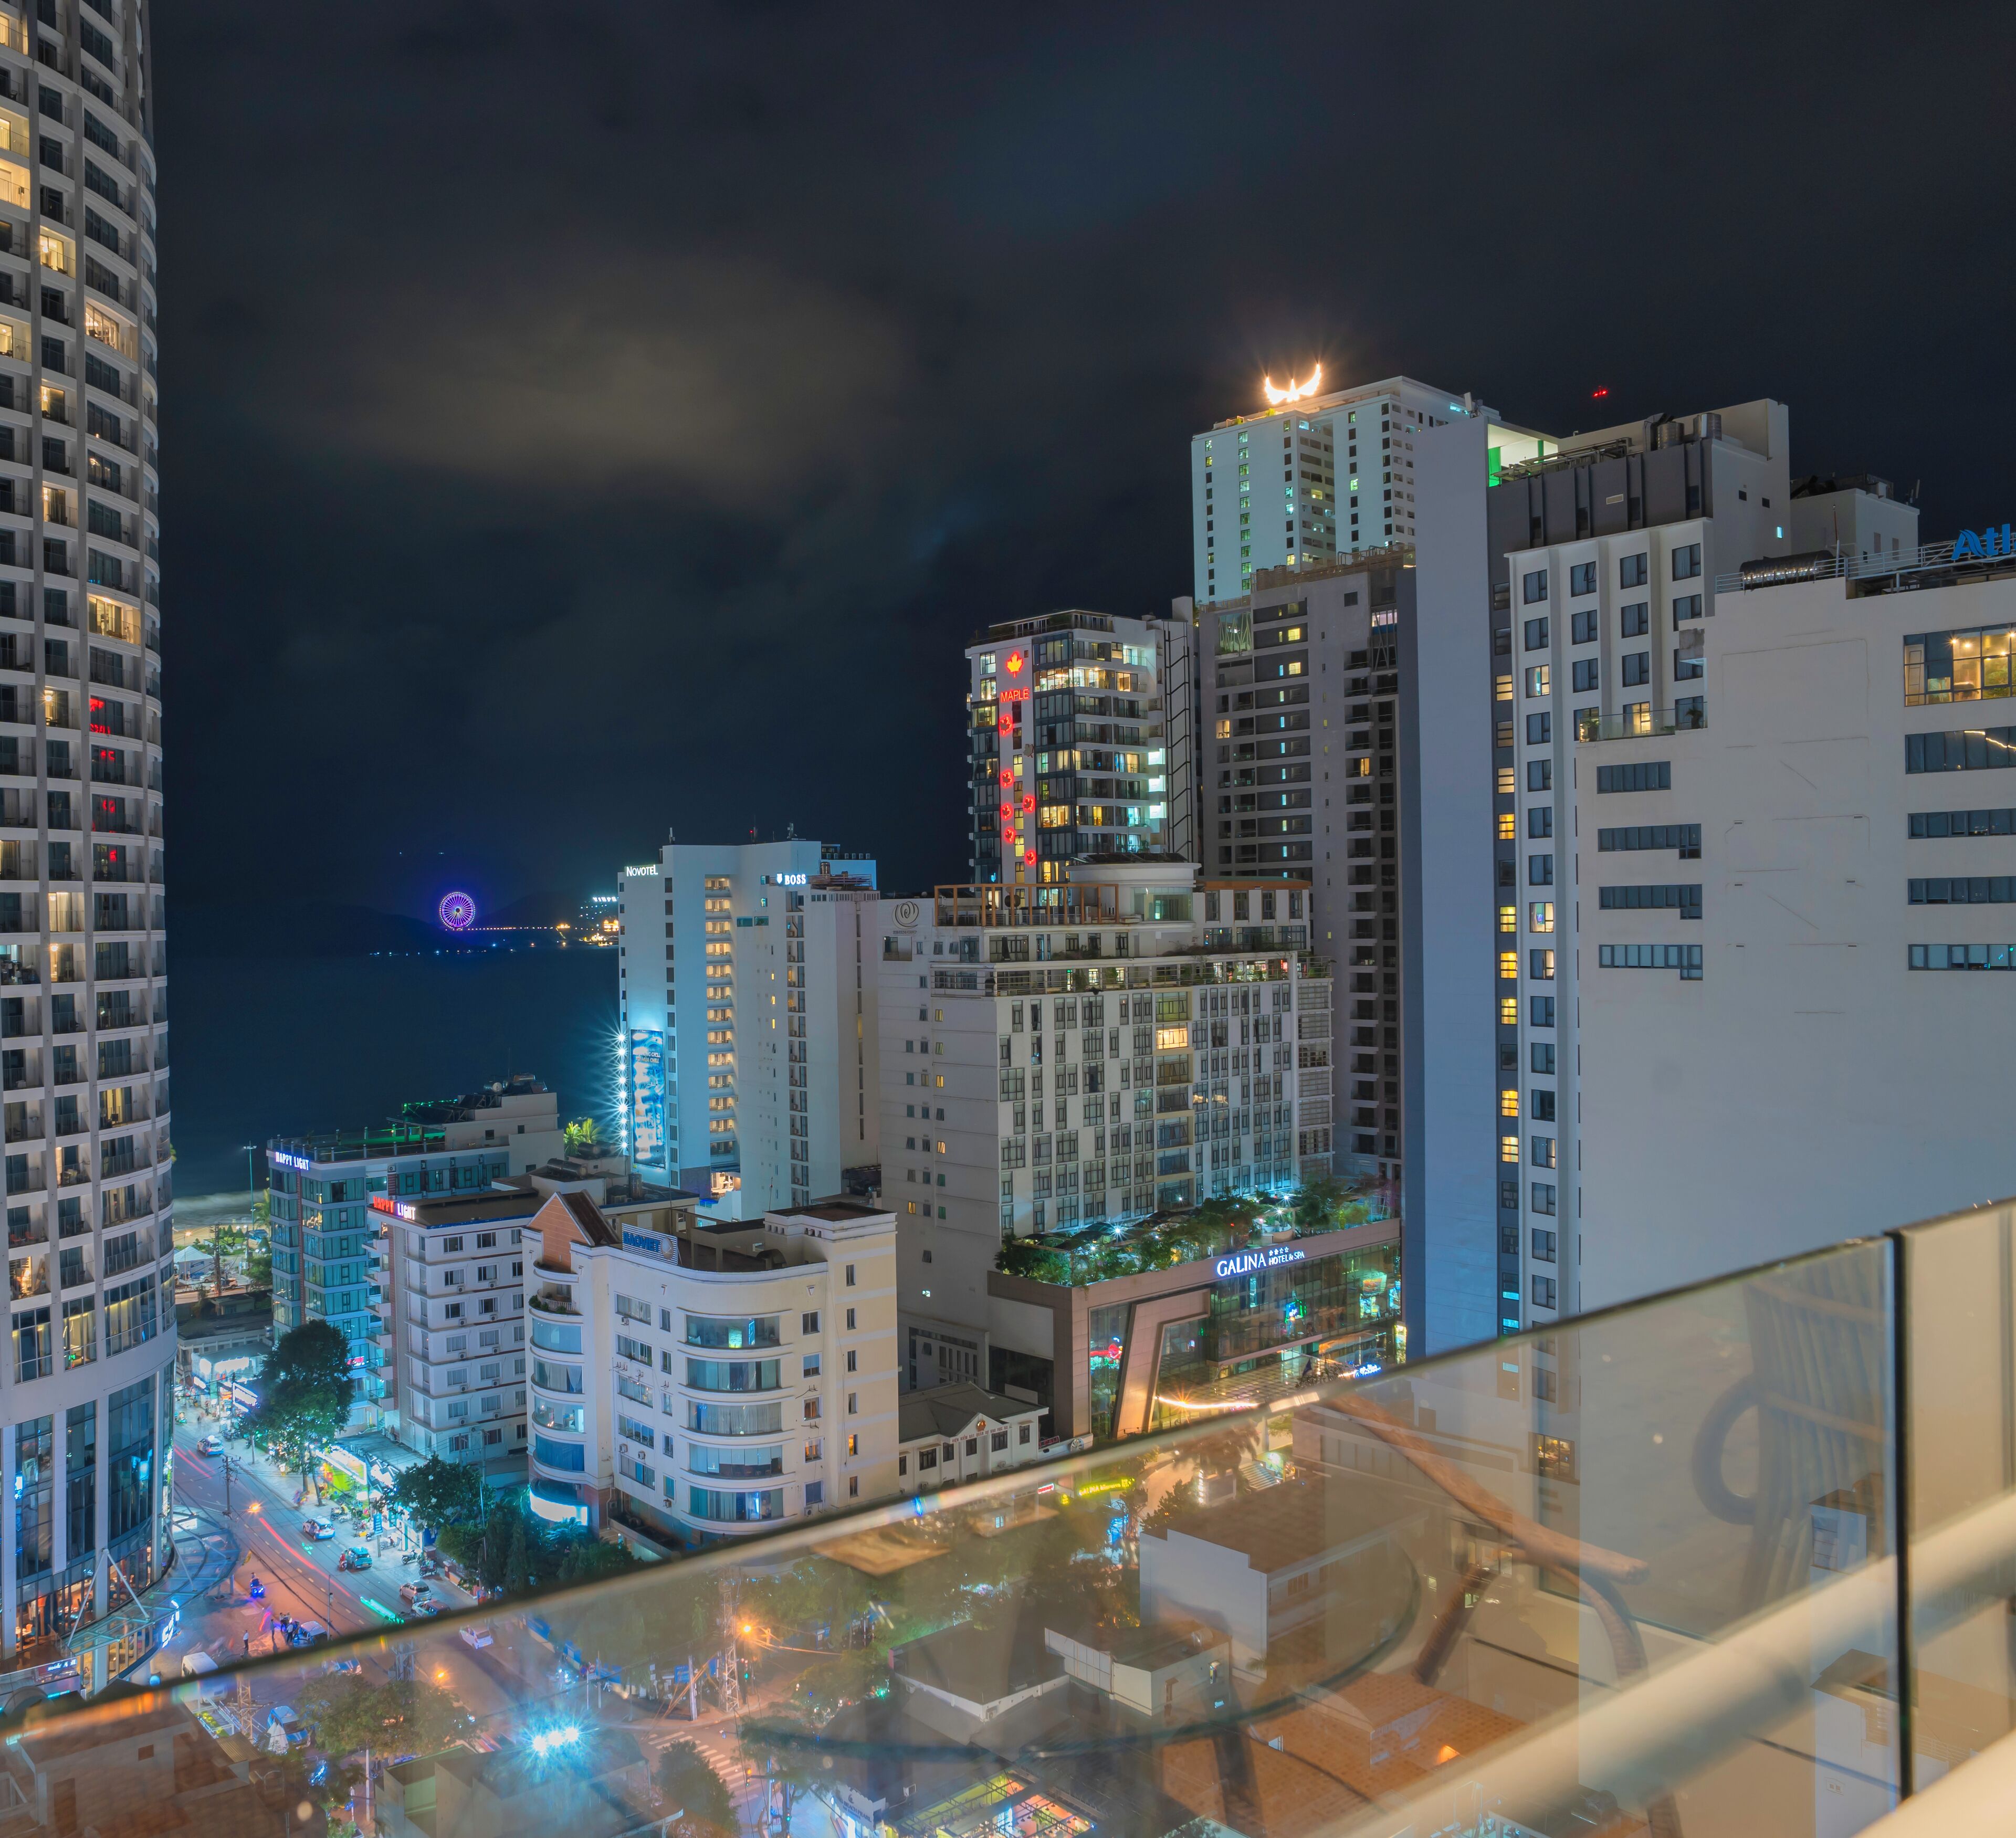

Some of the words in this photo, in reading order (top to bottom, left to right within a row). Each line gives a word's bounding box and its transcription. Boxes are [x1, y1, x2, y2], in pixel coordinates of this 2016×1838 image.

[1951, 523, 2016, 561] Atl
[1000, 688, 1030, 702] MAPLE
[626, 864, 659, 877] NOVOTEL
[784, 874, 806, 885] BOSS
[276, 1151, 292, 1166] HAPPY
[293, 1156, 309, 1171] LIGHT
[373, 1196, 394, 1214] HAPPY
[397, 1203, 415, 1220] LIGHT
[1216, 1253, 1267, 1277] GALINA
[1269, 1254, 1289, 1266] HOTEL
[1294, 1251, 1305, 1260] SPA
